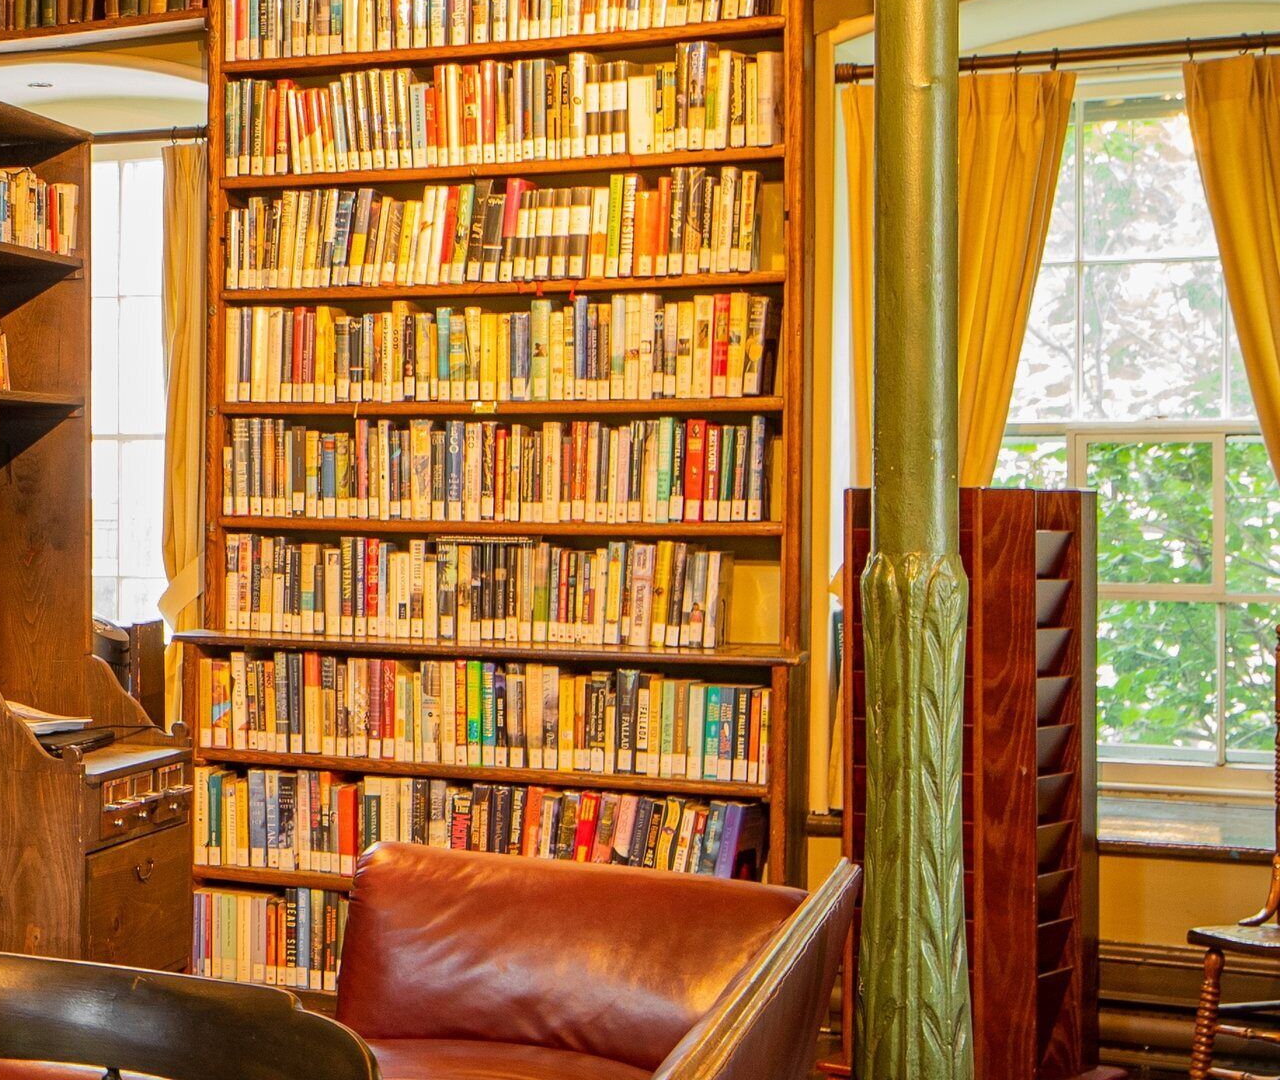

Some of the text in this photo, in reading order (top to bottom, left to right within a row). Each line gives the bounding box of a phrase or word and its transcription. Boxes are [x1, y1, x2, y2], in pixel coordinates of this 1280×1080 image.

[708, 429, 717, 471] ZEITOUN
[621, 716, 630, 750] FALLAD
[638, 706, 647, 741] FALLADA
[737, 694, 746, 735] TERRY FALLIS
